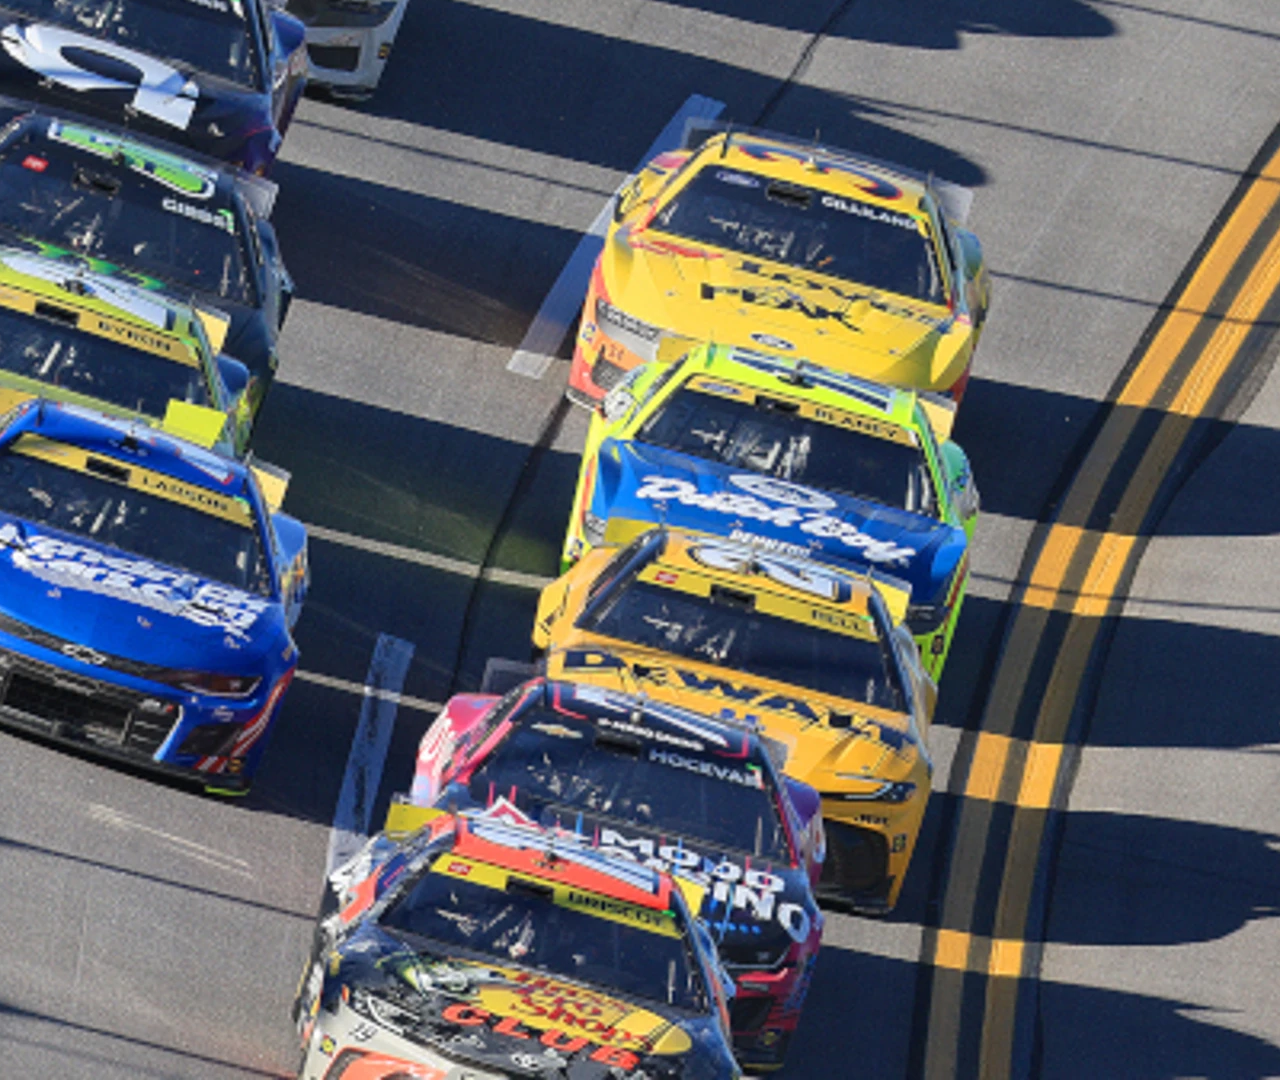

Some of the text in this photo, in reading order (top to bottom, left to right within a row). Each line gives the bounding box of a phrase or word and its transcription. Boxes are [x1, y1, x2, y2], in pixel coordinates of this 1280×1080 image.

[97, 320, 173, 353] BYRON
[814, 409, 899, 438] BLANEY
[142, 476, 229, 513] LARSON
[636, 475, 803, 528] Dutch
[800, 512, 917, 569] Boy
[441, 1002, 641, 1072] CLUB
